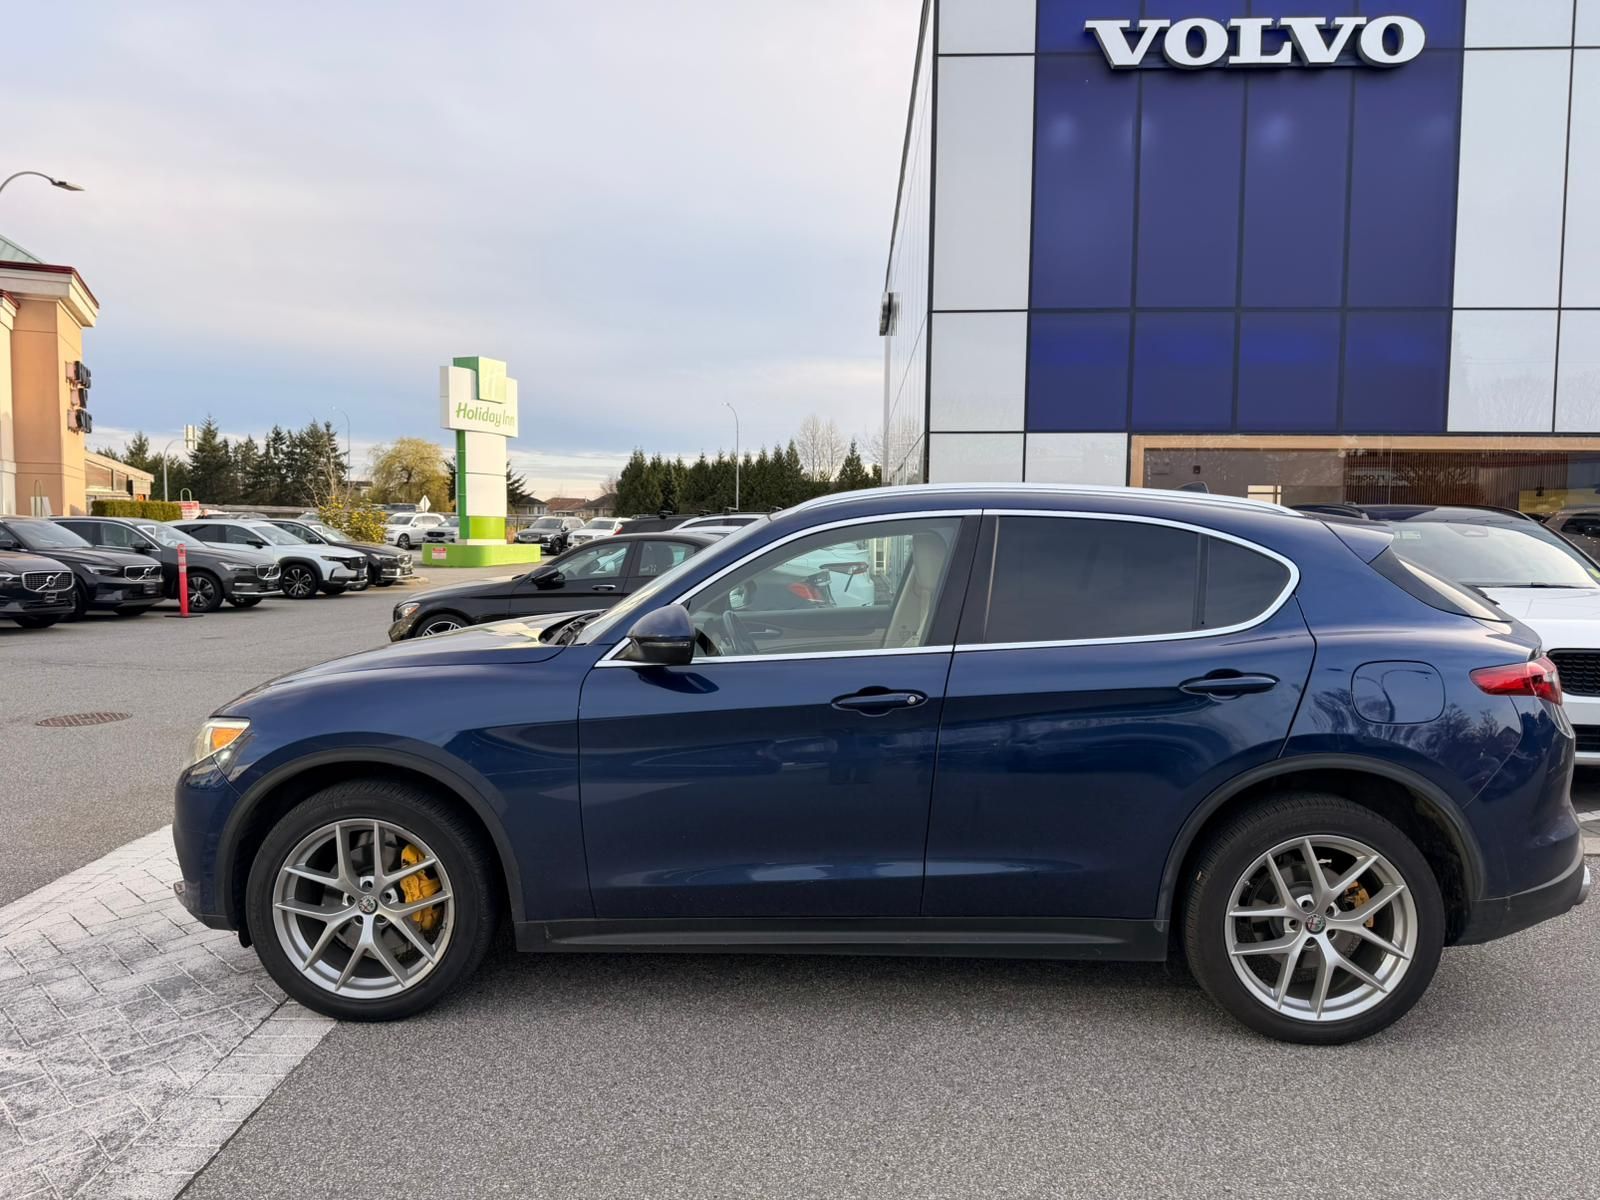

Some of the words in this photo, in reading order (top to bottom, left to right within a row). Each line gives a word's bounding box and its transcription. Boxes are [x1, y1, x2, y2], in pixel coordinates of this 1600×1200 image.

[1084, 15, 1426, 67] VOLVO
[456, 402, 501, 427] Holiday
[502, 409, 515, 425] Inn
